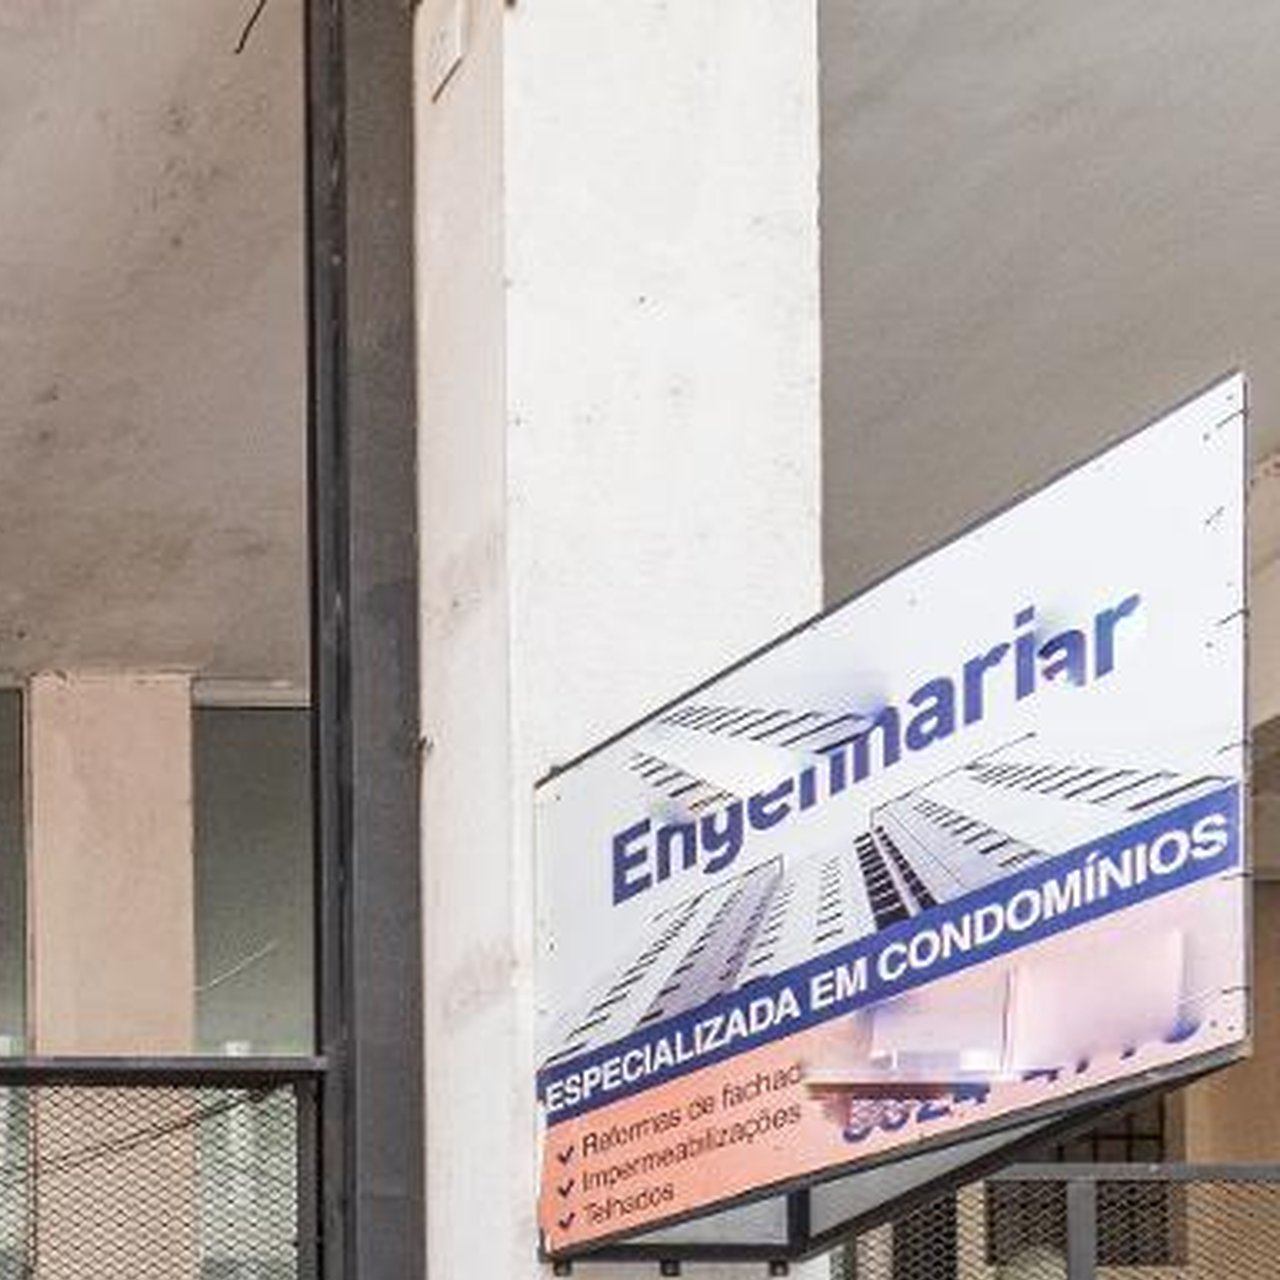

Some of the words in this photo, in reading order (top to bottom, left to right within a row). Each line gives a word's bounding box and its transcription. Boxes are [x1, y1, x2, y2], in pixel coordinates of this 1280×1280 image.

[544, 987, 801, 1112] ESPECIALIZADA
[810, 966, 868, 1011] EM
[877, 813, 1227, 981] CONDOMÍNIOS
[582, 1107, 681, 1157] Reformas
[688, 1096, 715, 1121] de
